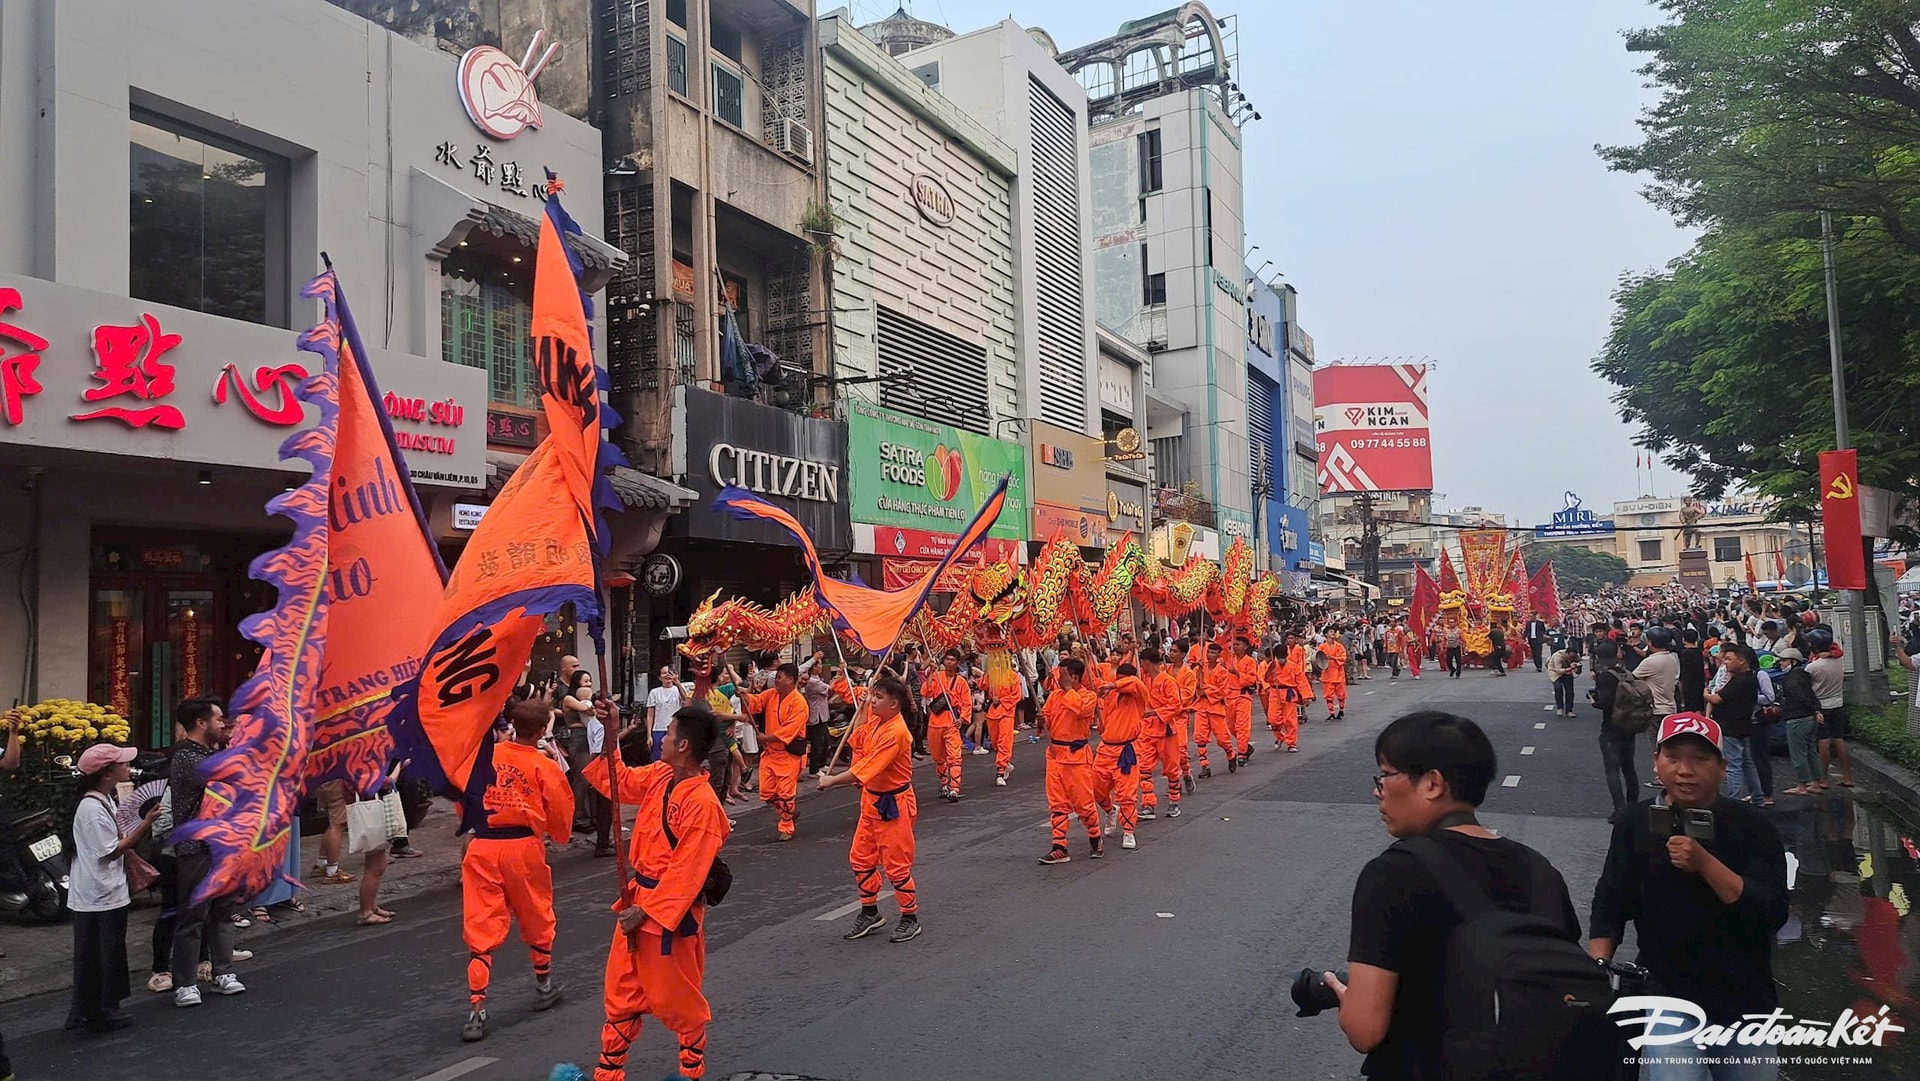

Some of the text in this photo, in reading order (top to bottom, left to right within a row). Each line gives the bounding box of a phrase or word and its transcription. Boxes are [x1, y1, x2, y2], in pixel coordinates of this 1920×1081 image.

[916, 180, 951, 219] SATRA
[1367, 406, 1394, 416] KIM
[1368, 416, 1409, 426] NGAN
[880, 441, 925, 467] SATRA
[1351, 438, 1426, 449] 09 77 44 55 88
[709, 443, 839, 503] CITIZEN
[881, 462, 926, 487] FOODS
[878, 494, 892, 511] CỬA
[892, 497, 911, 514] HÀNG
[434, 628, 500, 708] NG
[317, 669, 389, 708] TRANG
